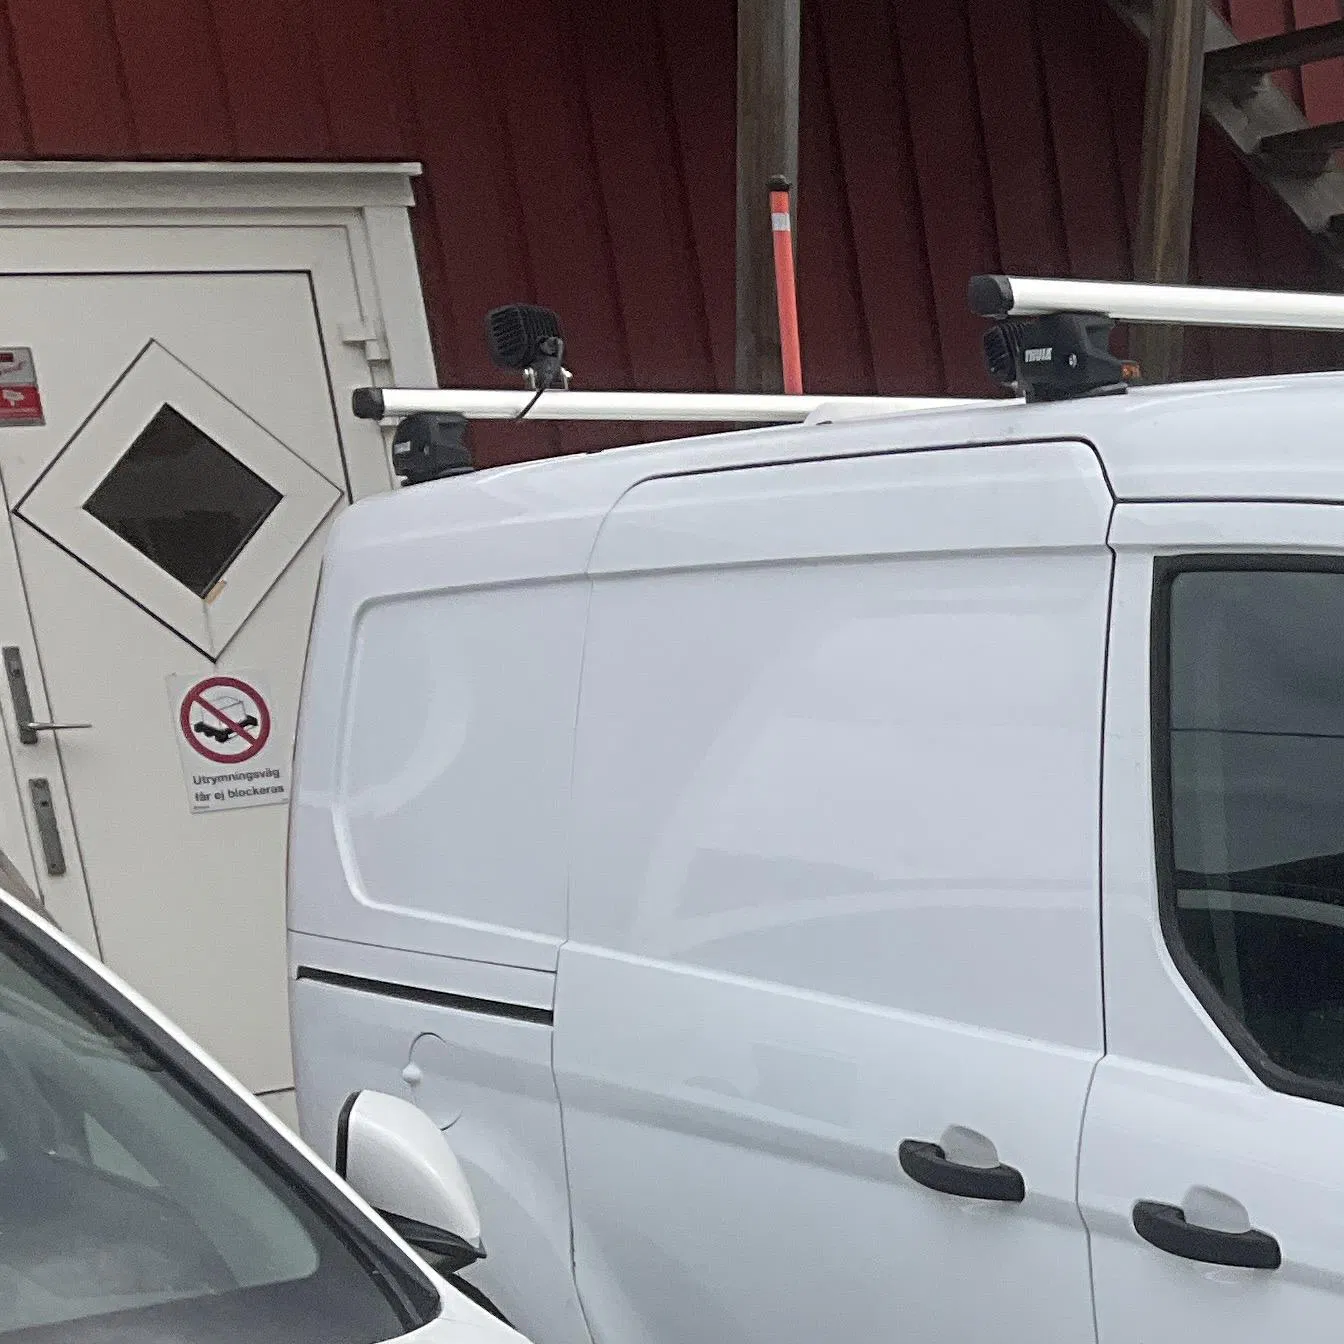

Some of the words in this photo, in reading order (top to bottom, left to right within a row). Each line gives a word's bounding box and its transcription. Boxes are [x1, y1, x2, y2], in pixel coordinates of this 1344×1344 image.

[192, 768, 280, 786] Utrymningsväg
[214, 789, 225, 801] ej
[227, 785, 285, 799] blockeras
